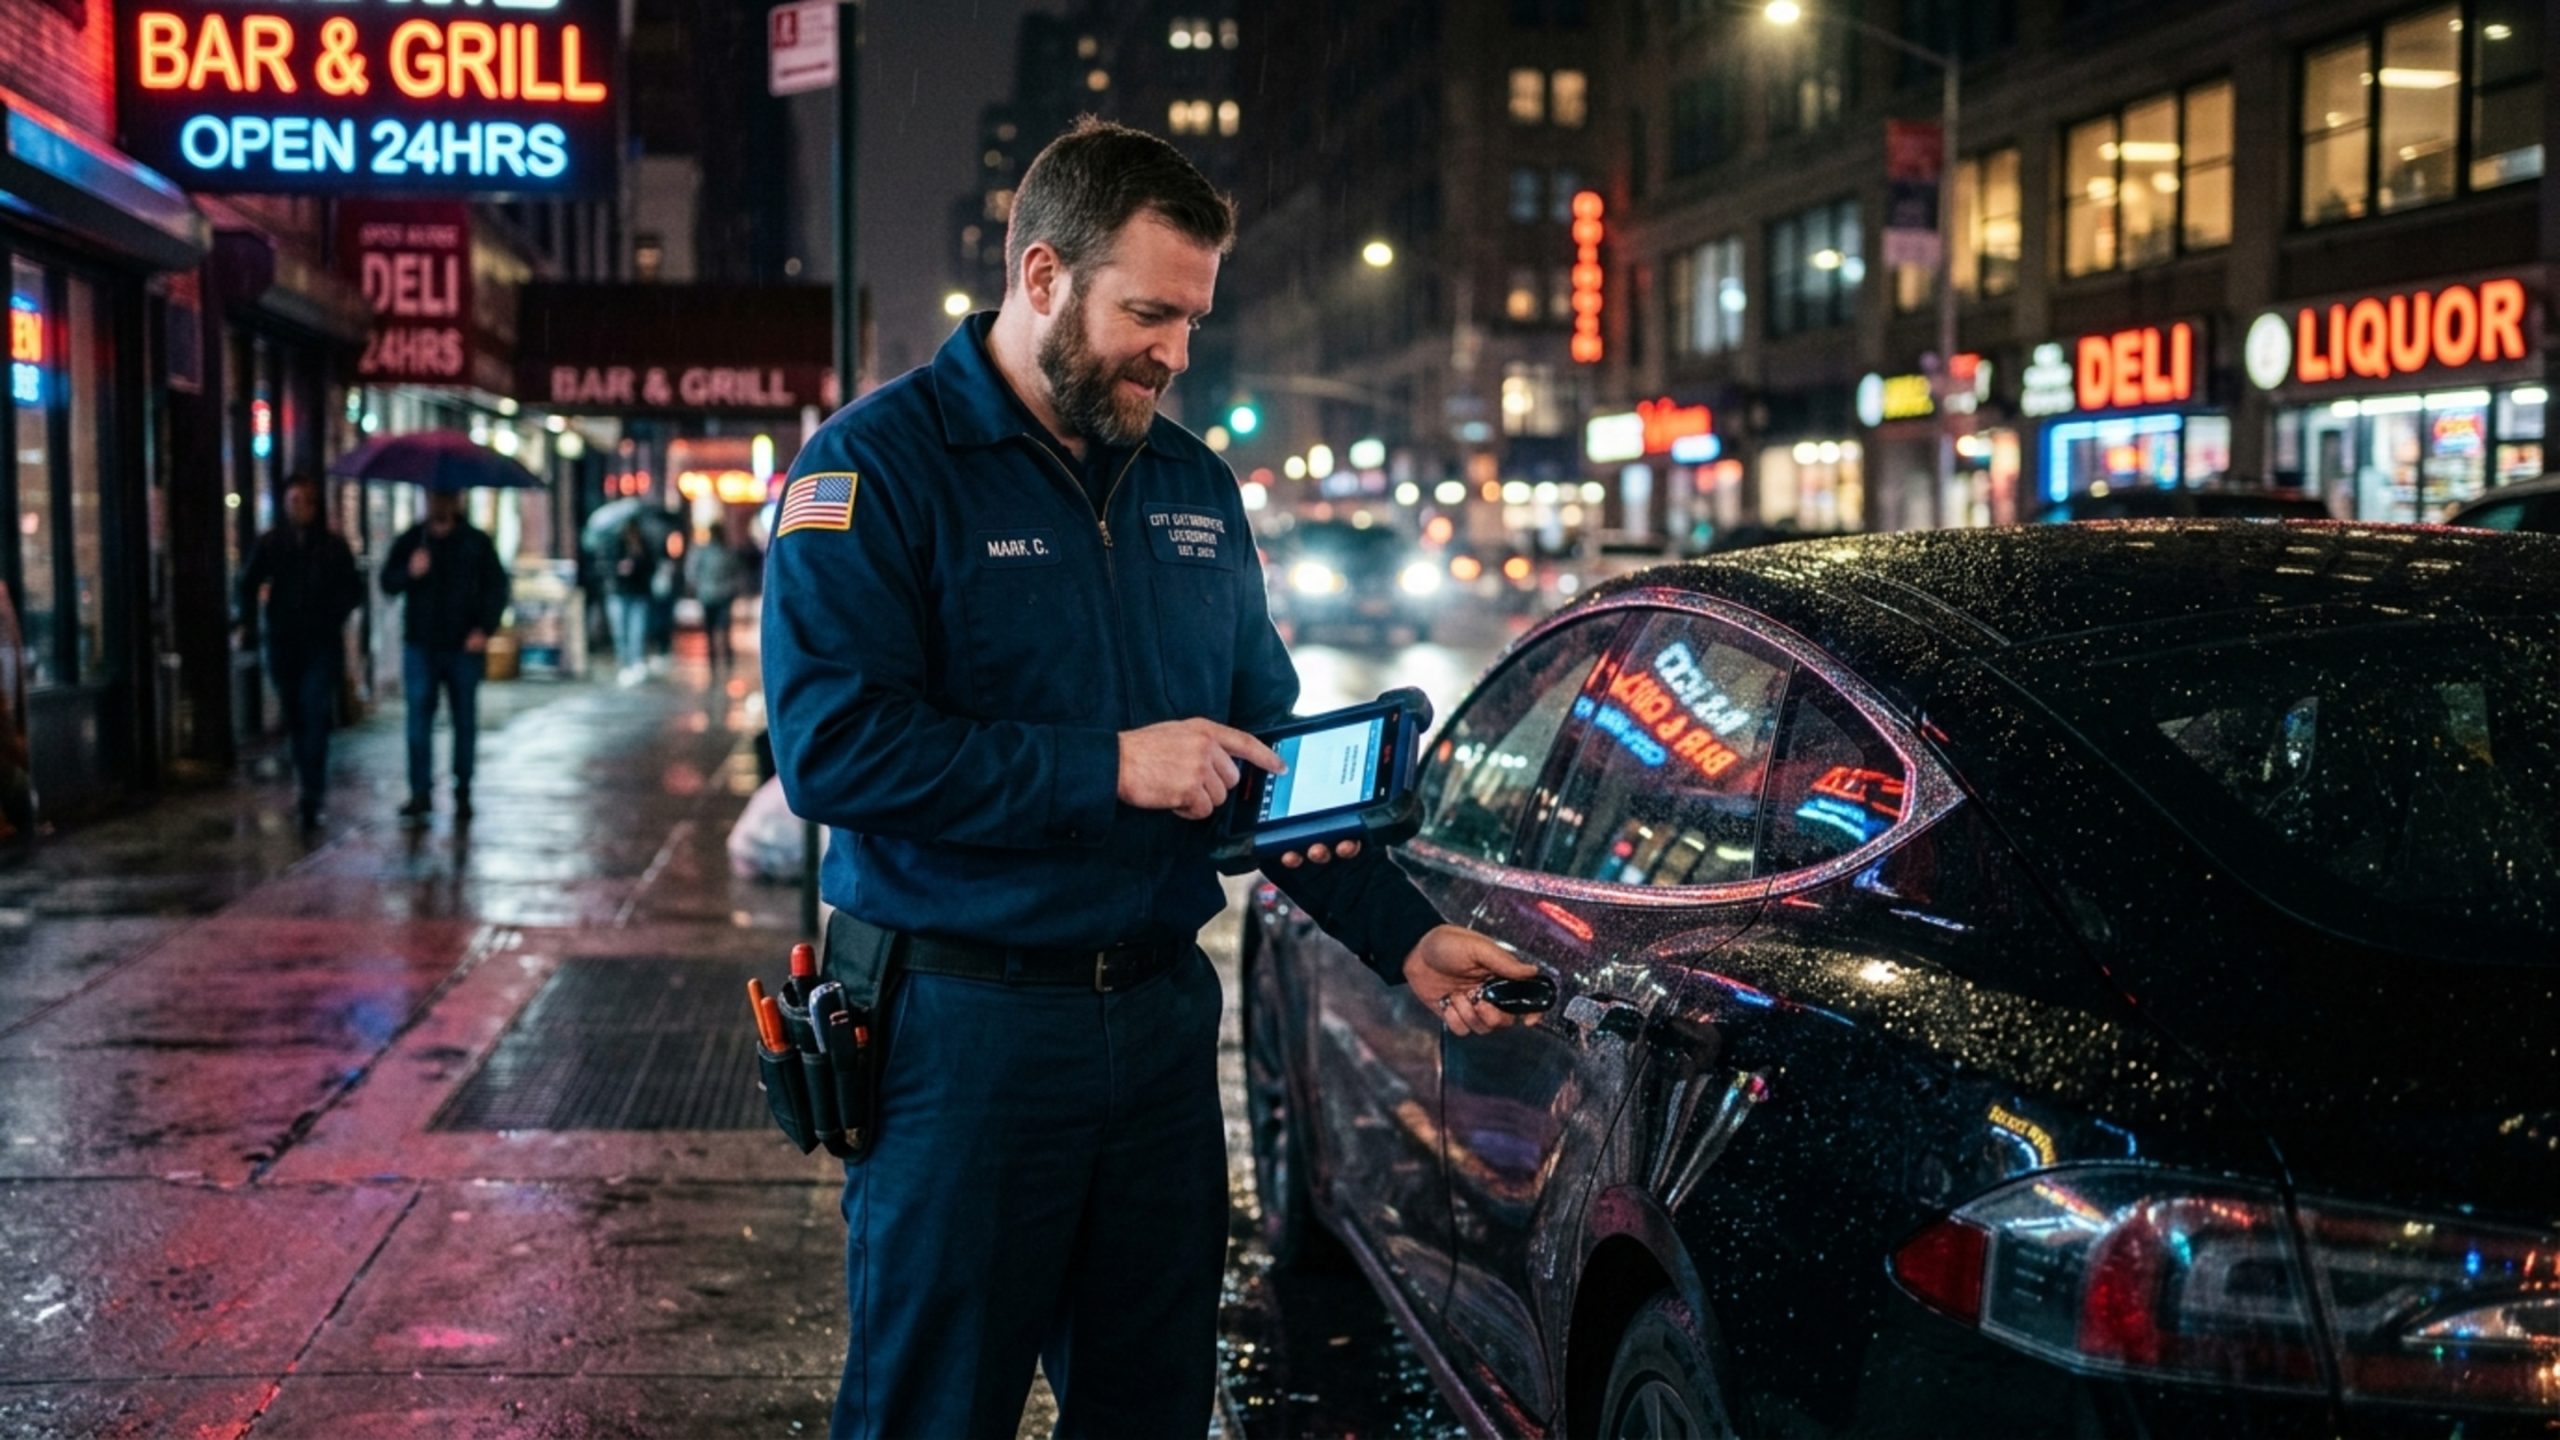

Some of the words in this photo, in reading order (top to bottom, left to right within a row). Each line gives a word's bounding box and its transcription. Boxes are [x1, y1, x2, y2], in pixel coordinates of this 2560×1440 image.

[138, 11, 298, 94] BAR
[315, 16, 370, 97] &
[388, 18, 607, 102] GRILL
[180, 114, 356, 173] OPEN
[370, 119, 569, 178] 24HRS
[361, 252, 460, 317] DELI
[2296, 277, 2526, 383] LIQUOR
[551, 364, 636, 406] BAR
[642, 366, 673, 406] &
[679, 367, 796, 407] GRILL
[2077, 321, 2192, 411] DELI
[1032, 537, 1050, 556] C.
